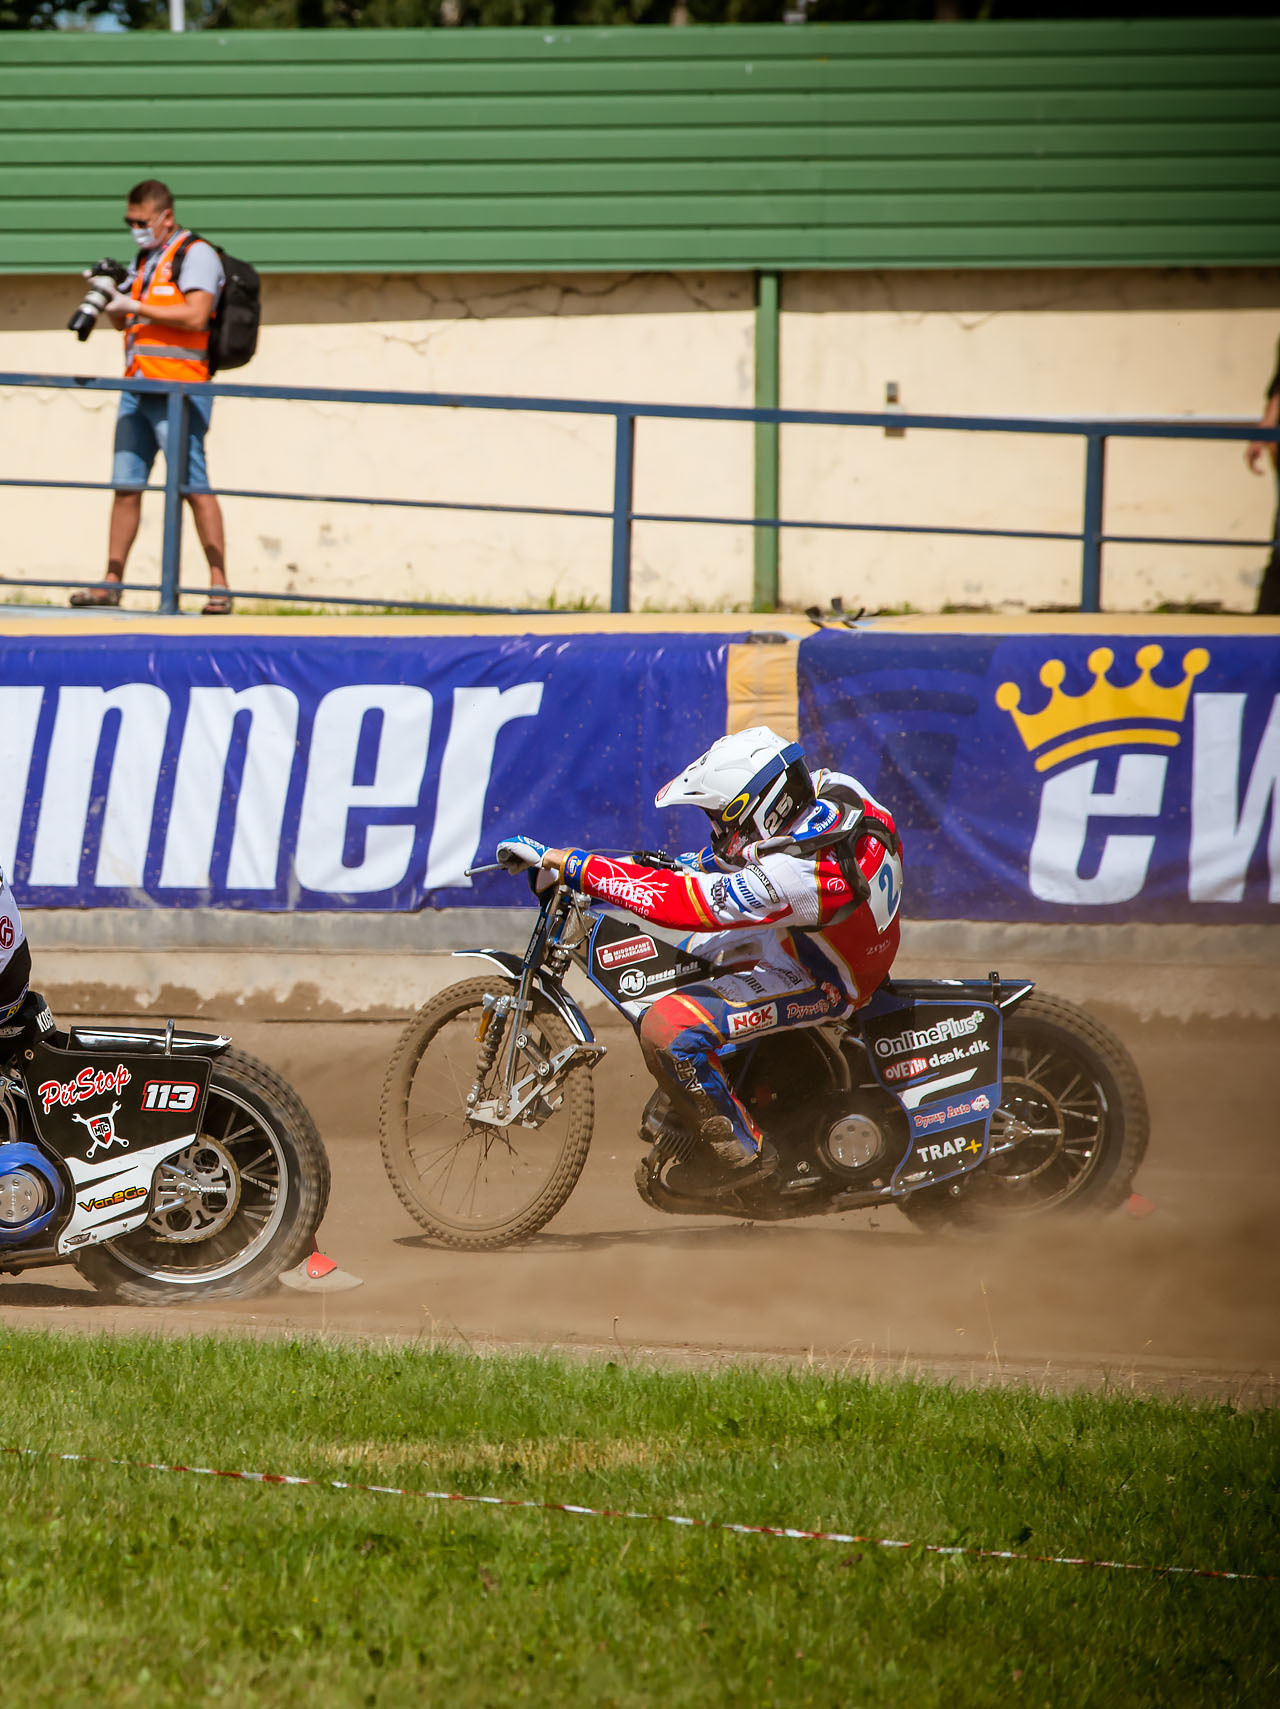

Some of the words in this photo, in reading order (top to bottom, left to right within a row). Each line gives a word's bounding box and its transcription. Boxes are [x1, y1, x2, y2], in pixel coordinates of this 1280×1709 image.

[764, 792, 794, 837] 25
[597, 876, 655, 908] AVIDES
[878, 863, 899, 917] 2
[733, 1006, 773, 1031] NGK
[928, 1040, 991, 1068] dæk.dk
[38, 1064, 132, 1115] PitStop
[144, 1083, 197, 1110] 113
[947, 1103, 971, 1119] Auto
[93, 1123, 112, 1137] MTC
[78, 1186, 150, 1212] Van2Go
